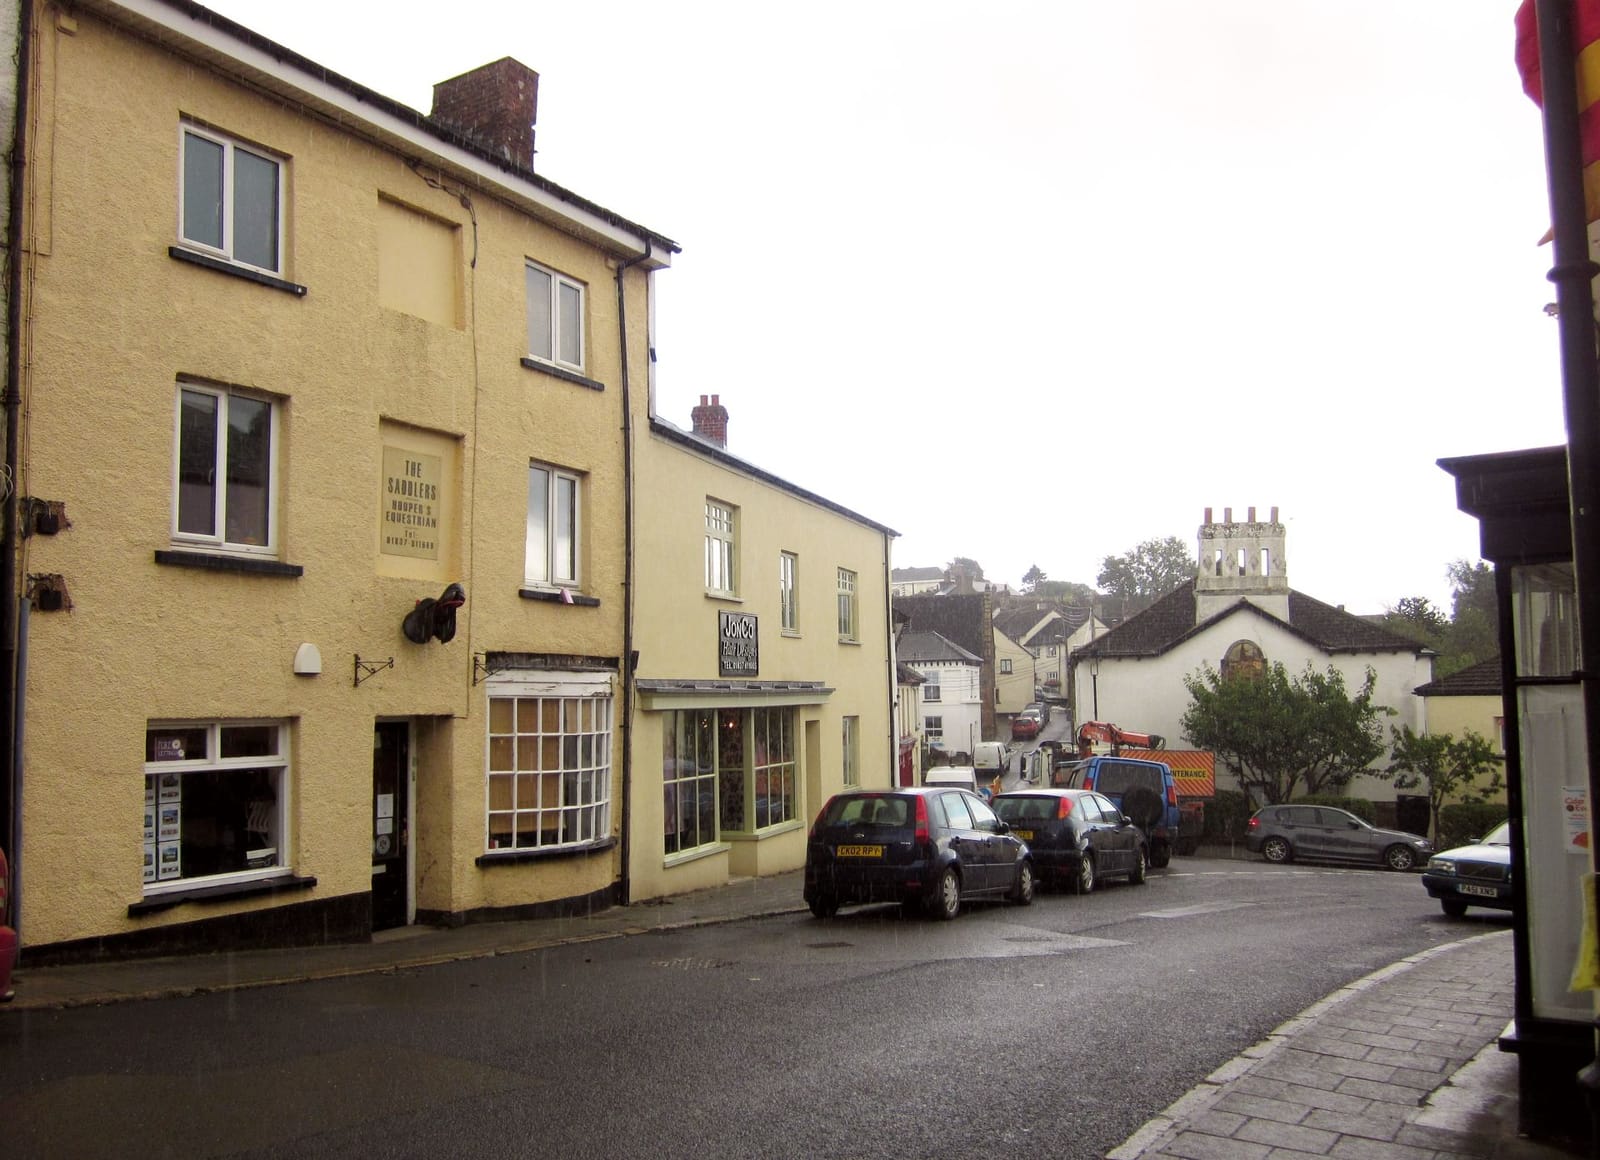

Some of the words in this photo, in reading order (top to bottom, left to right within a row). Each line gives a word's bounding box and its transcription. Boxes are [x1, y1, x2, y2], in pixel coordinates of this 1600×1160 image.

[405, 460, 422, 478] THE
[388, 478, 436, 500] SADDLERS
[386, 511, 436, 528] EQUESTRIAN
[840, 846, 861, 856] CK02
